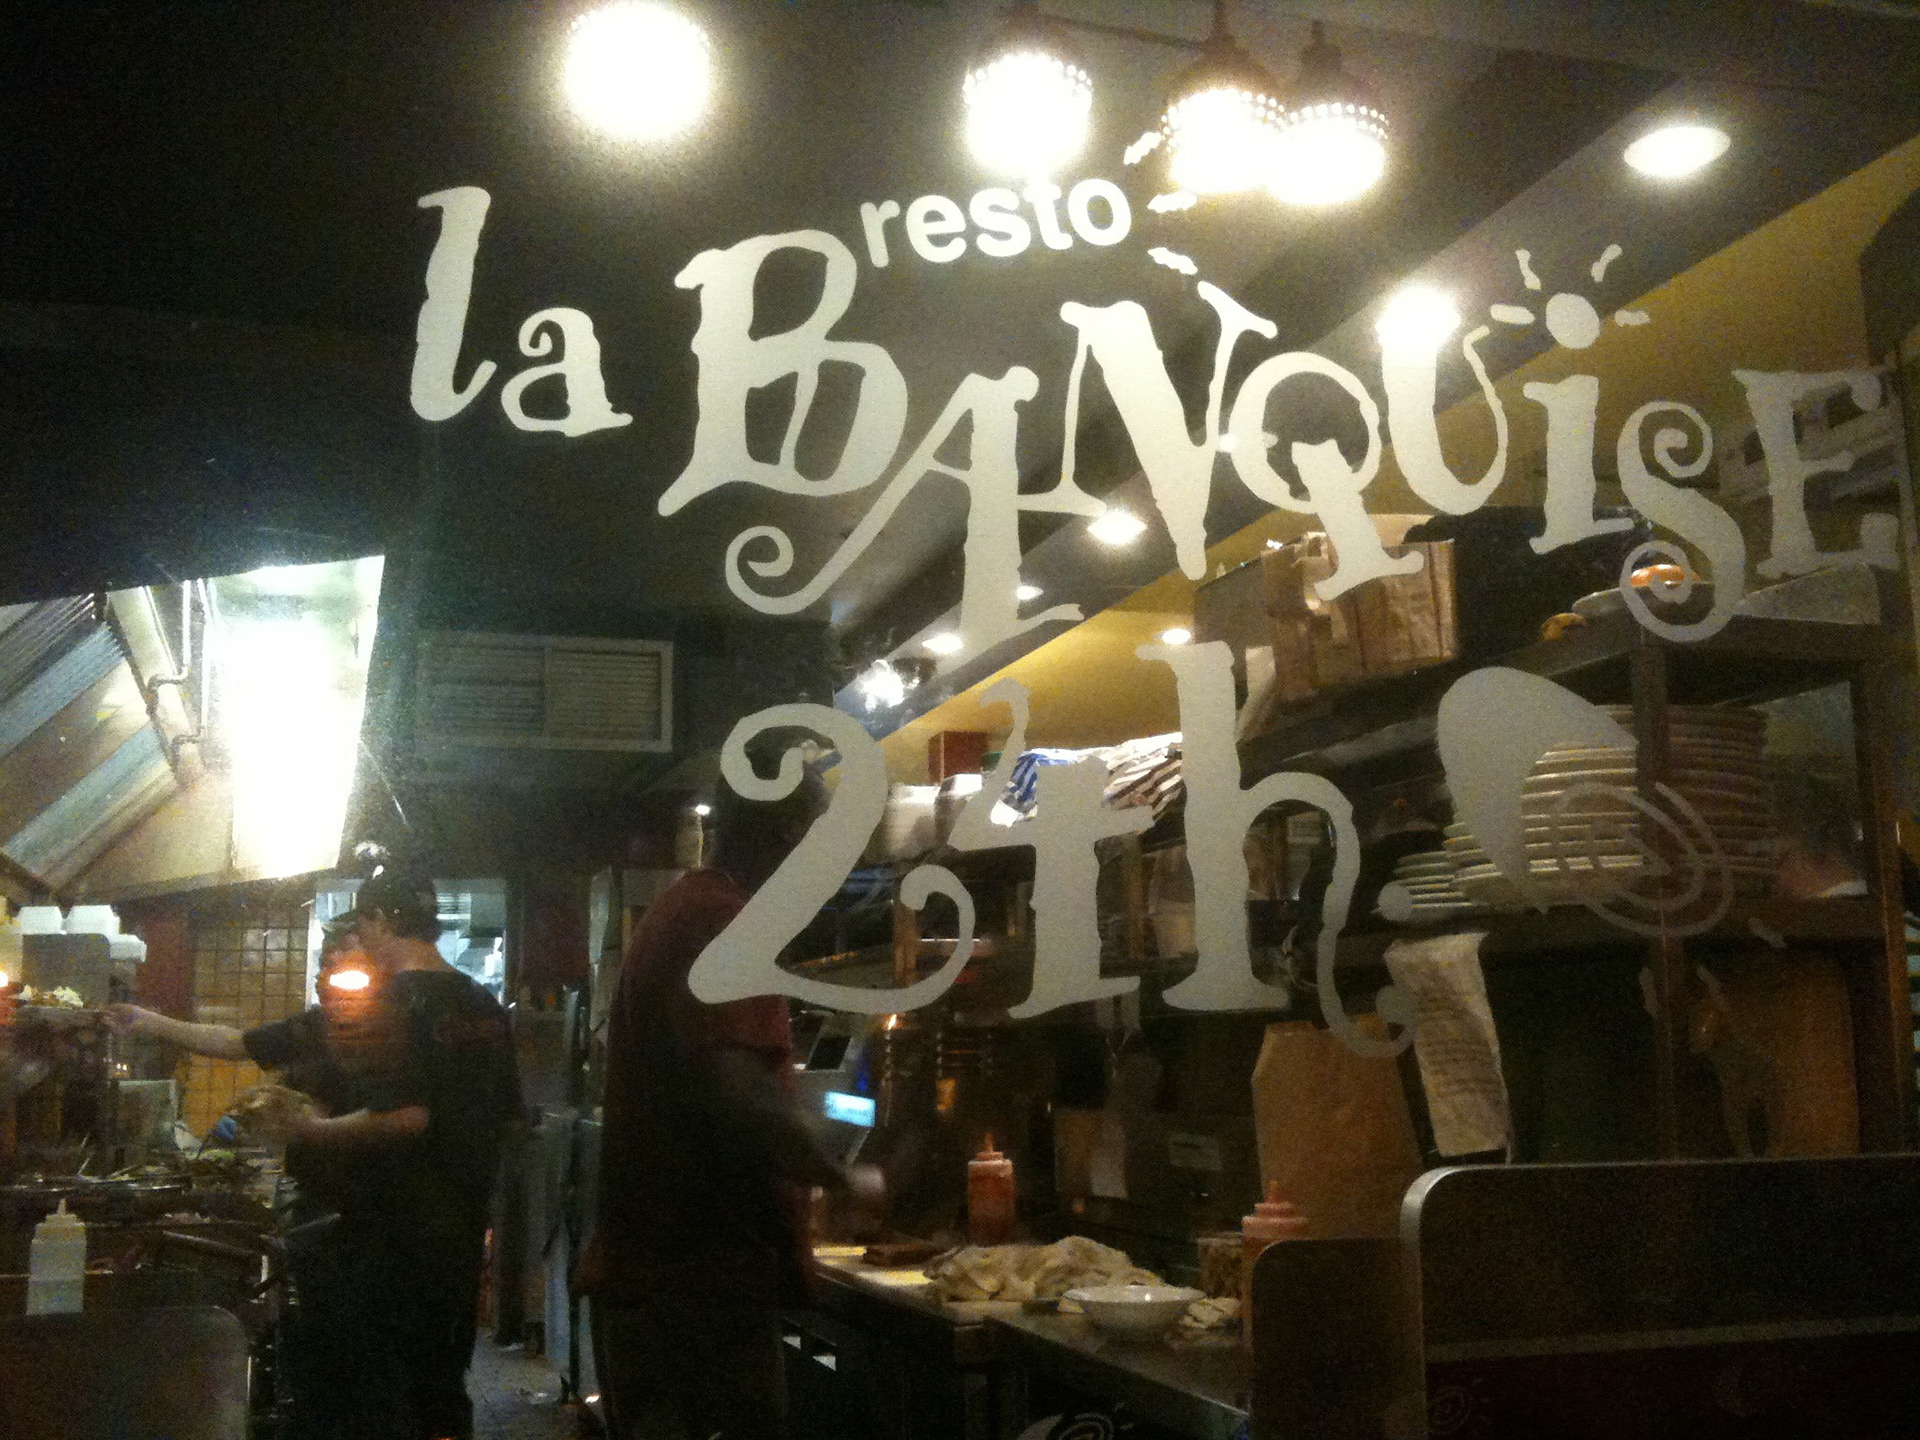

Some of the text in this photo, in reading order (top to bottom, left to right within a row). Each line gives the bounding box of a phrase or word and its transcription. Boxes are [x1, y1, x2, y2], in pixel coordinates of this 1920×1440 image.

[409, 185, 634, 438] la
[859, 177, 1132, 268] resto
[687, 640, 1418, 1058] 24h
